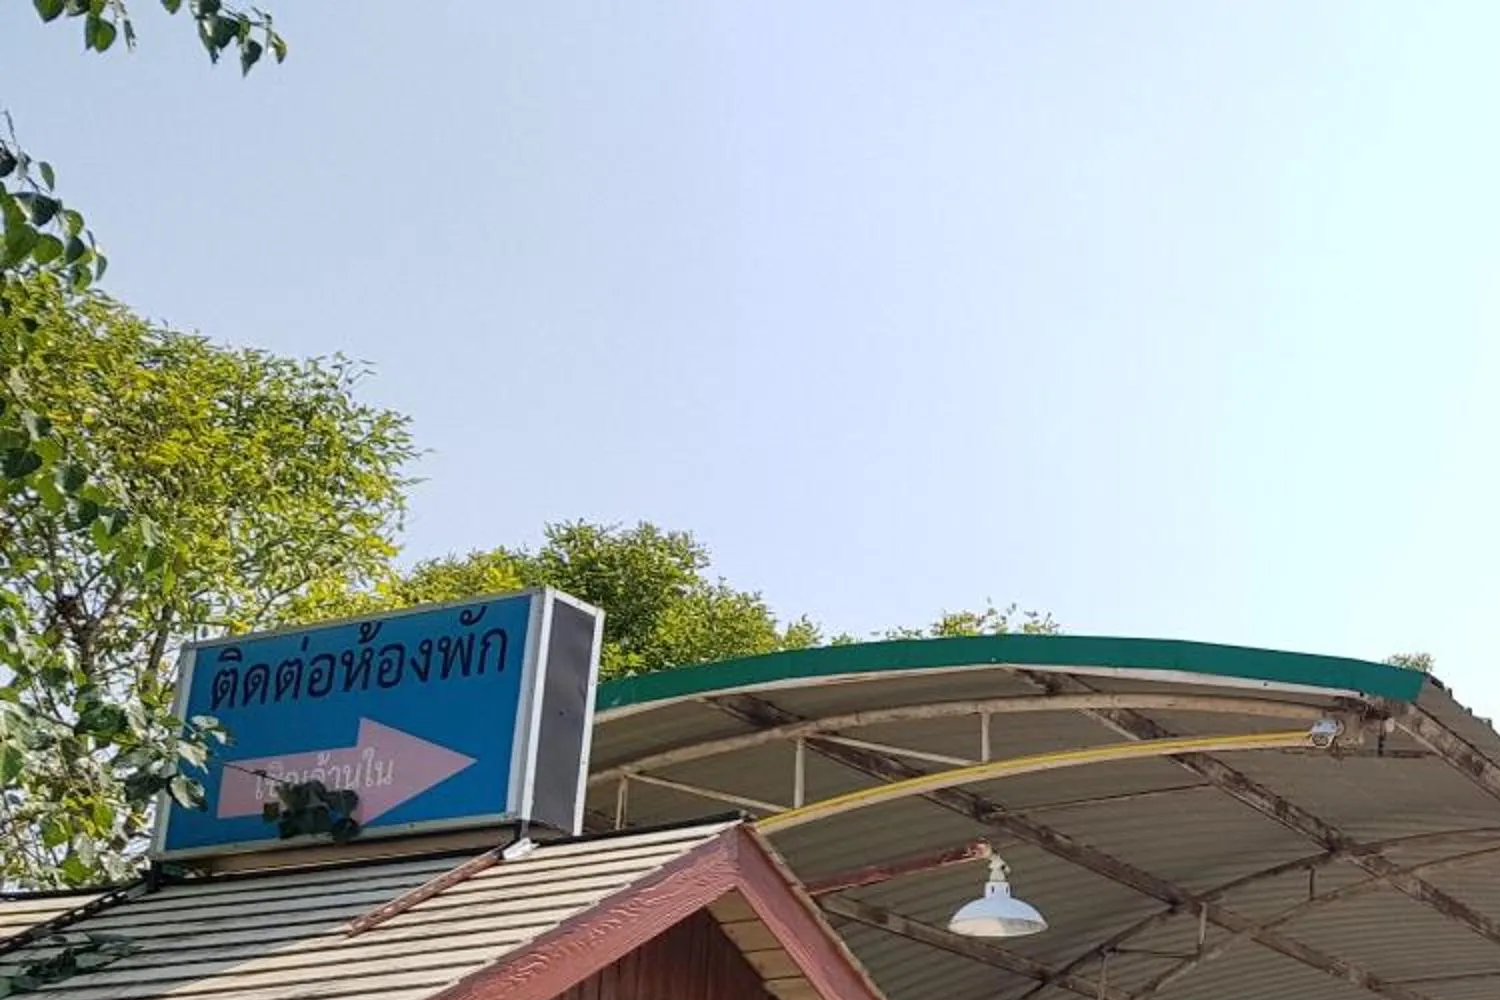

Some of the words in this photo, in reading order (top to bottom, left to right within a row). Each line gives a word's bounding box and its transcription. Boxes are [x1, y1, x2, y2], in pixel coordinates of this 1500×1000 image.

[211, 606, 507, 711] ติดต่อห้องพัก
